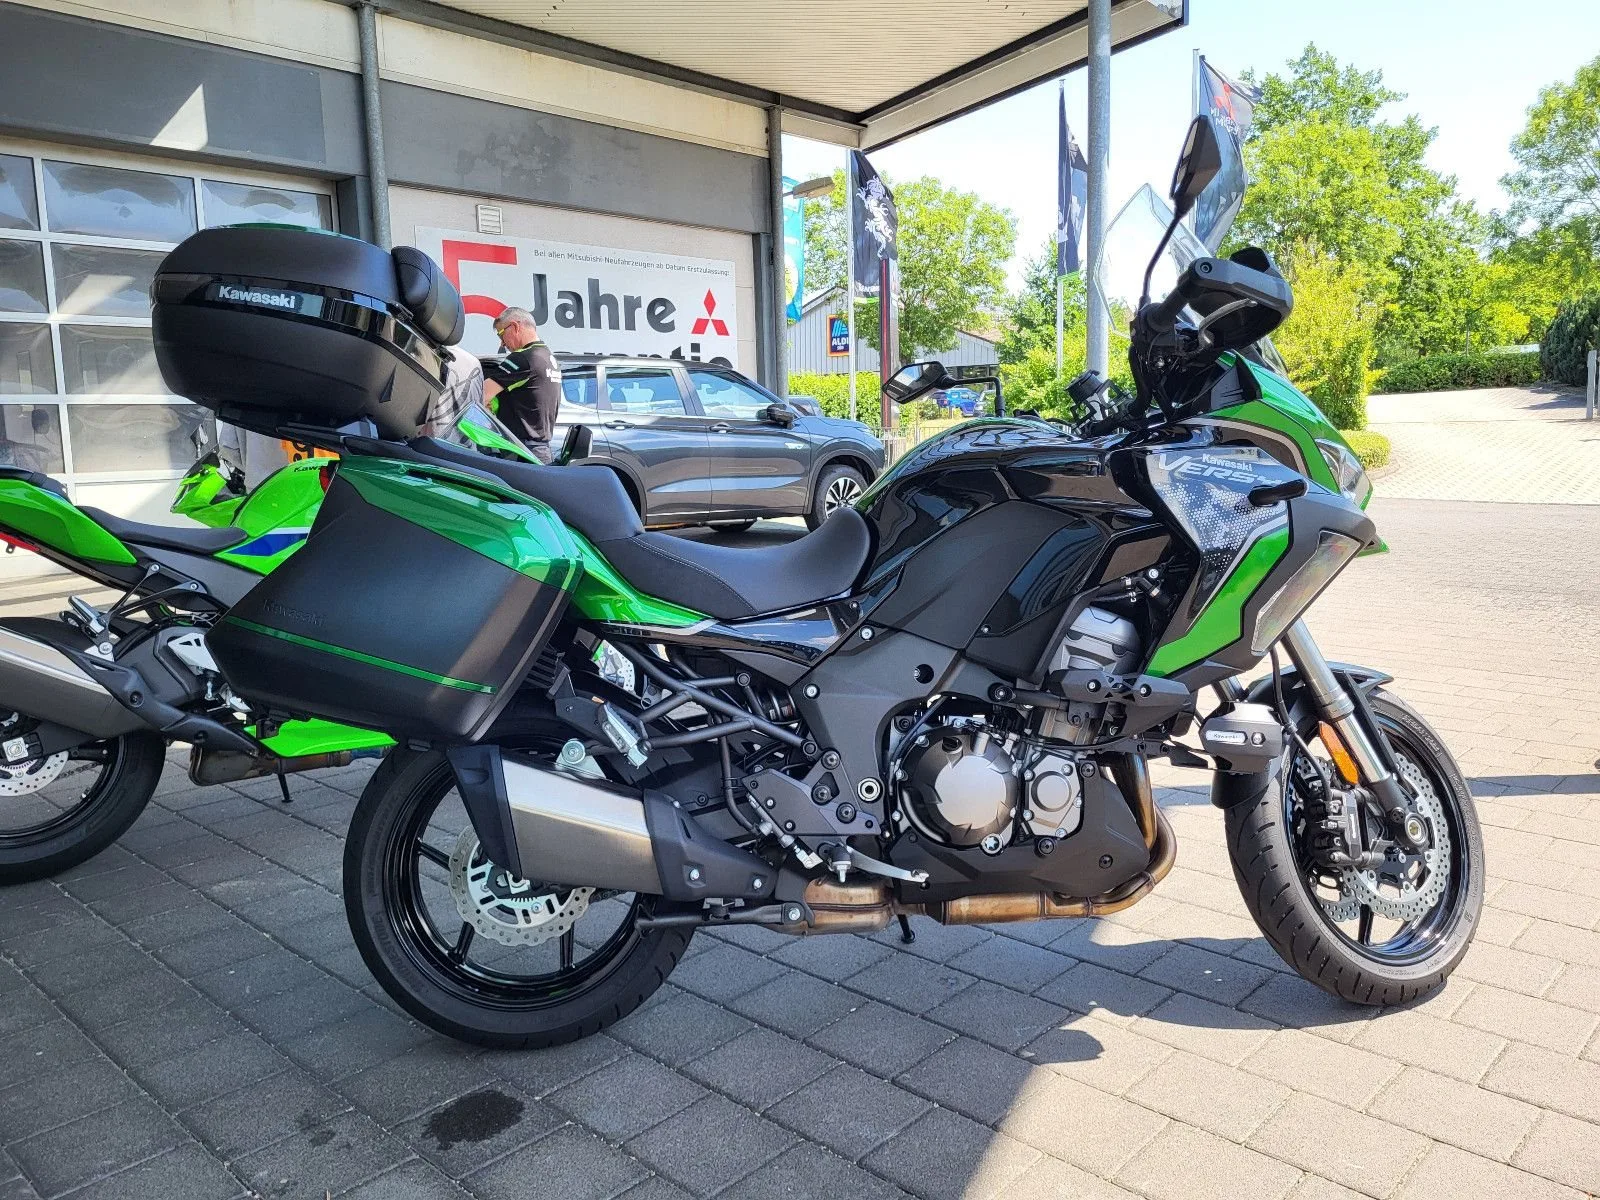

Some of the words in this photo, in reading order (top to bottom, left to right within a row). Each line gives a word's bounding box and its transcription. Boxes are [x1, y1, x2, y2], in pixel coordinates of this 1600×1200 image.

[534, 249, 546, 257] Bei
[548, 251, 566, 260] allen
[567, 252, 603, 263] Mitsubishi
[604, 256, 655, 269] Neufahrzeugen
[665, 263, 686, 272] Datum
[219, 285, 296, 309] Kawasaki
[529, 273, 677, 333] Jahre
[1201, 453, 1252, 472] Kawasaki
